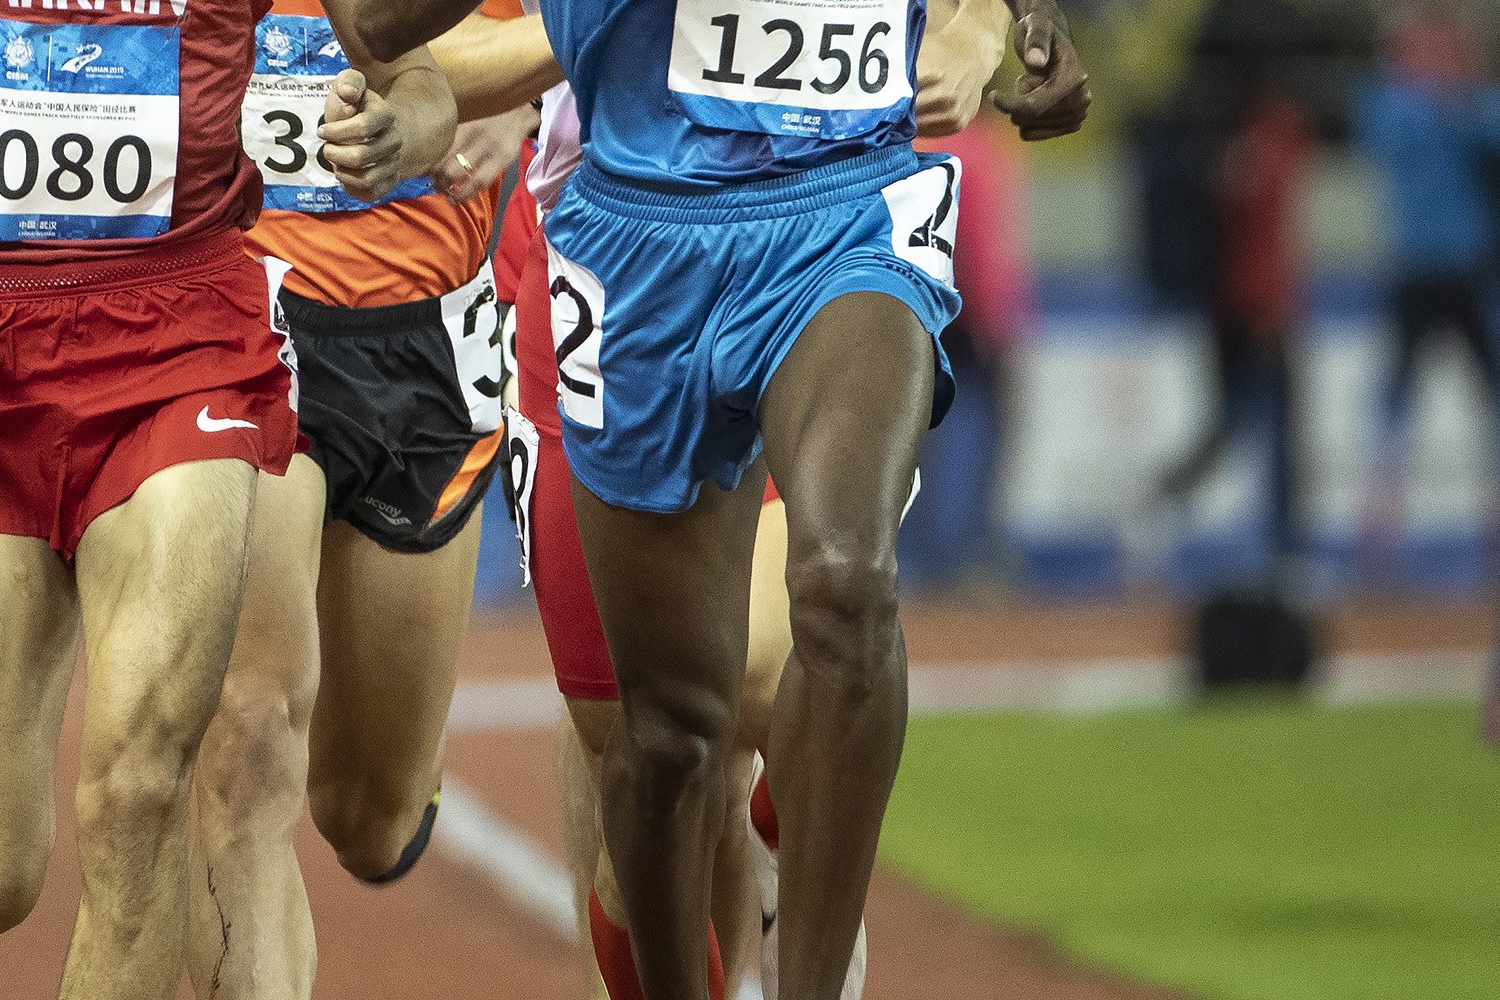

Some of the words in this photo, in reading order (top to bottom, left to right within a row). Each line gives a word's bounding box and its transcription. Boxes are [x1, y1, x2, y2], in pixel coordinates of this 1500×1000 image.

[6, 70, 29, 81] CISM
[702, 13, 892, 95] 1256
[908, 162, 956, 260] 2
[550, 275, 597, 399] 2
